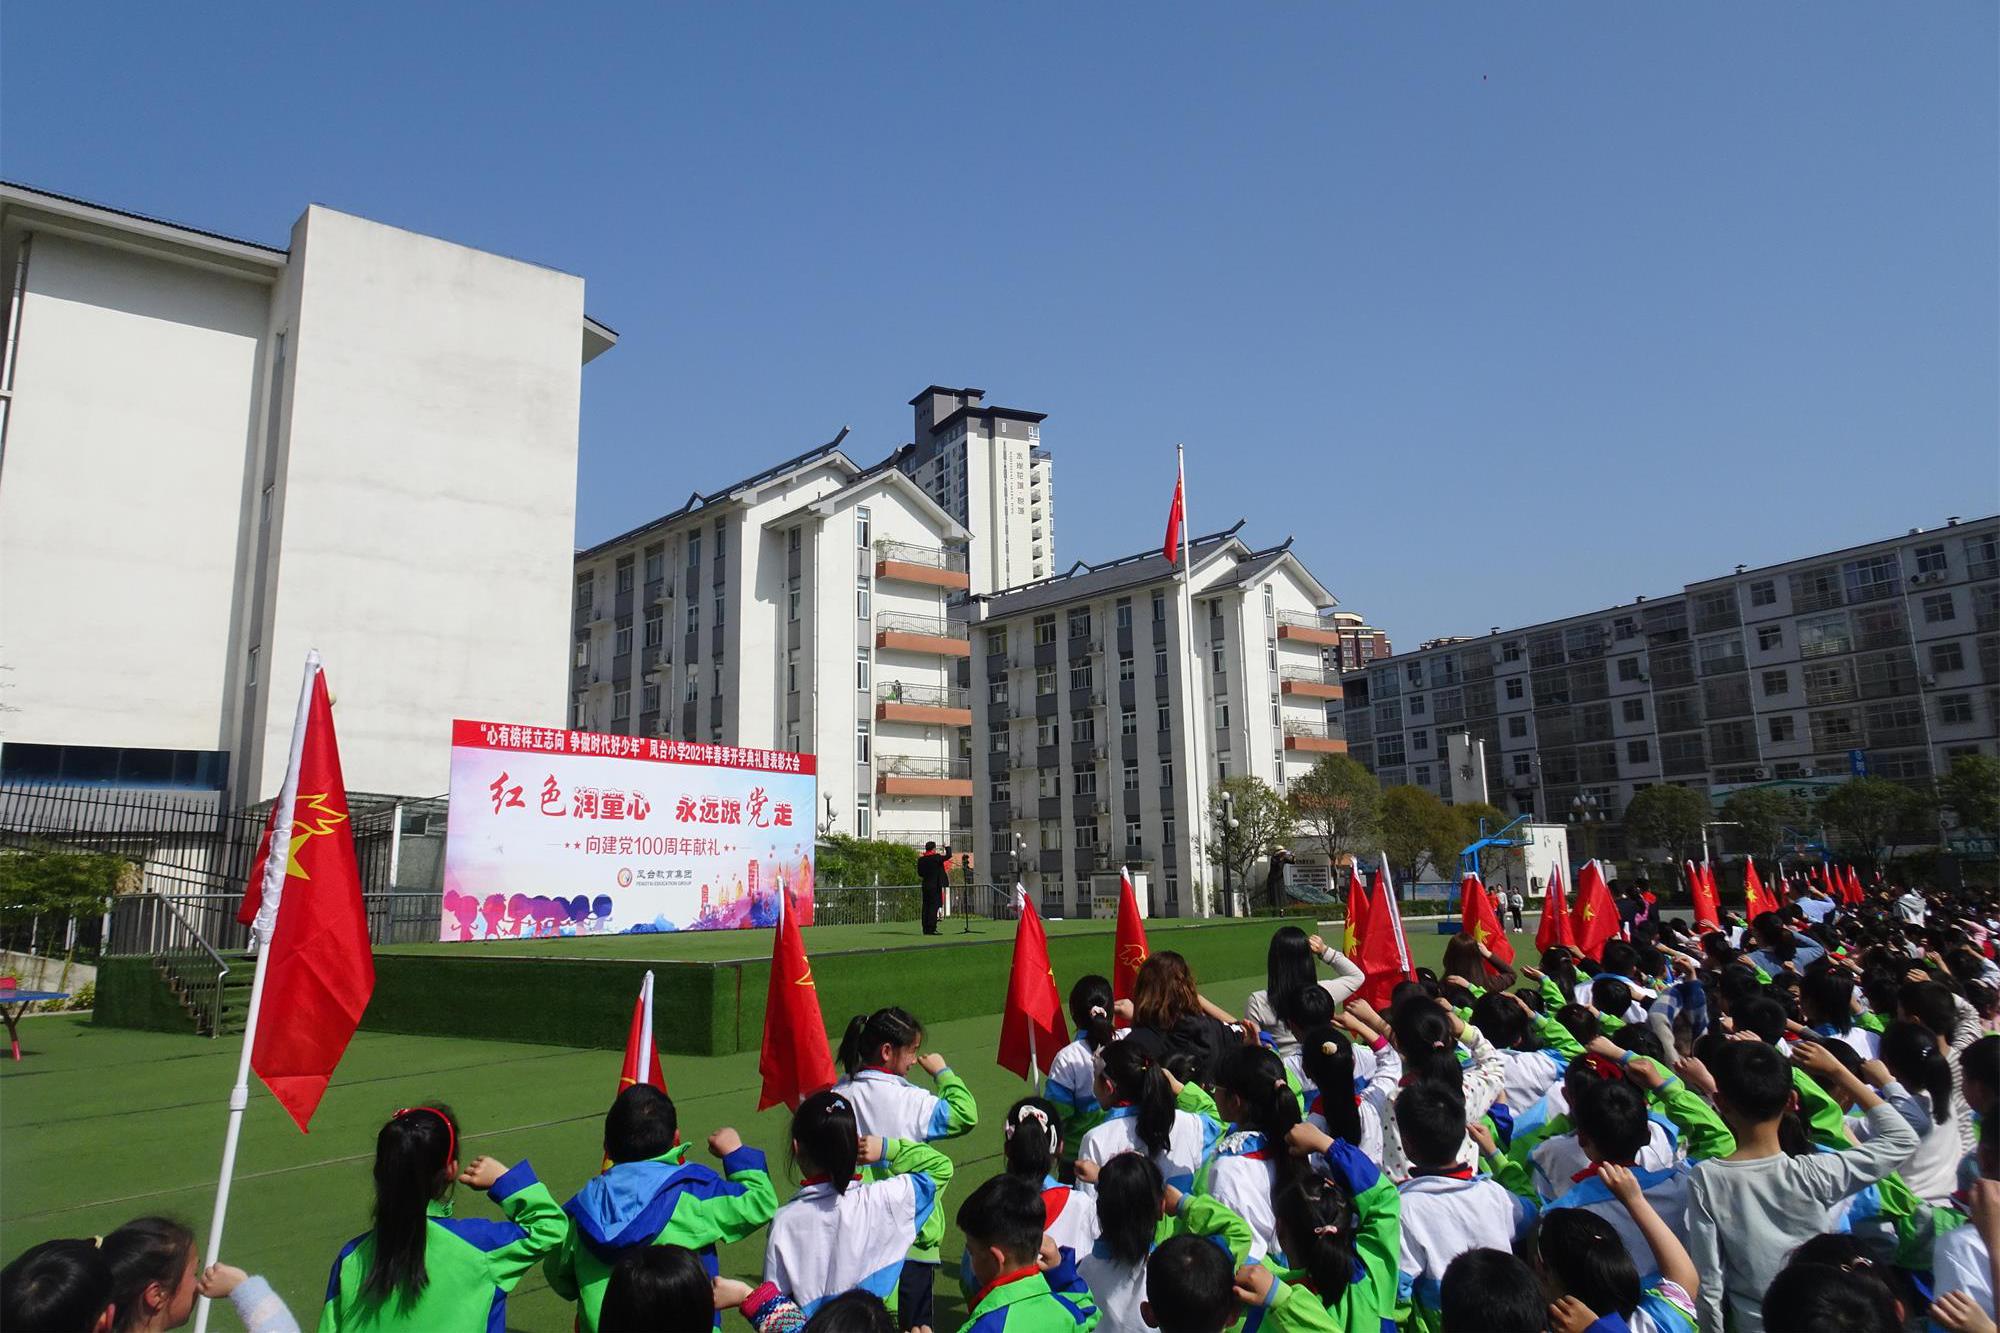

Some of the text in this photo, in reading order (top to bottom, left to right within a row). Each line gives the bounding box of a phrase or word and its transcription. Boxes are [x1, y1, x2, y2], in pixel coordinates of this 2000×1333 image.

[480, 724, 801, 771] “心有榜样立志向 争做时代好少年” 凤台小学2021年春季开学典礼暨表彰大会
[490, 771, 793, 828] 红色润童心 永远跟党走
[585, 836, 721, 856] 向建党100周年献礼
